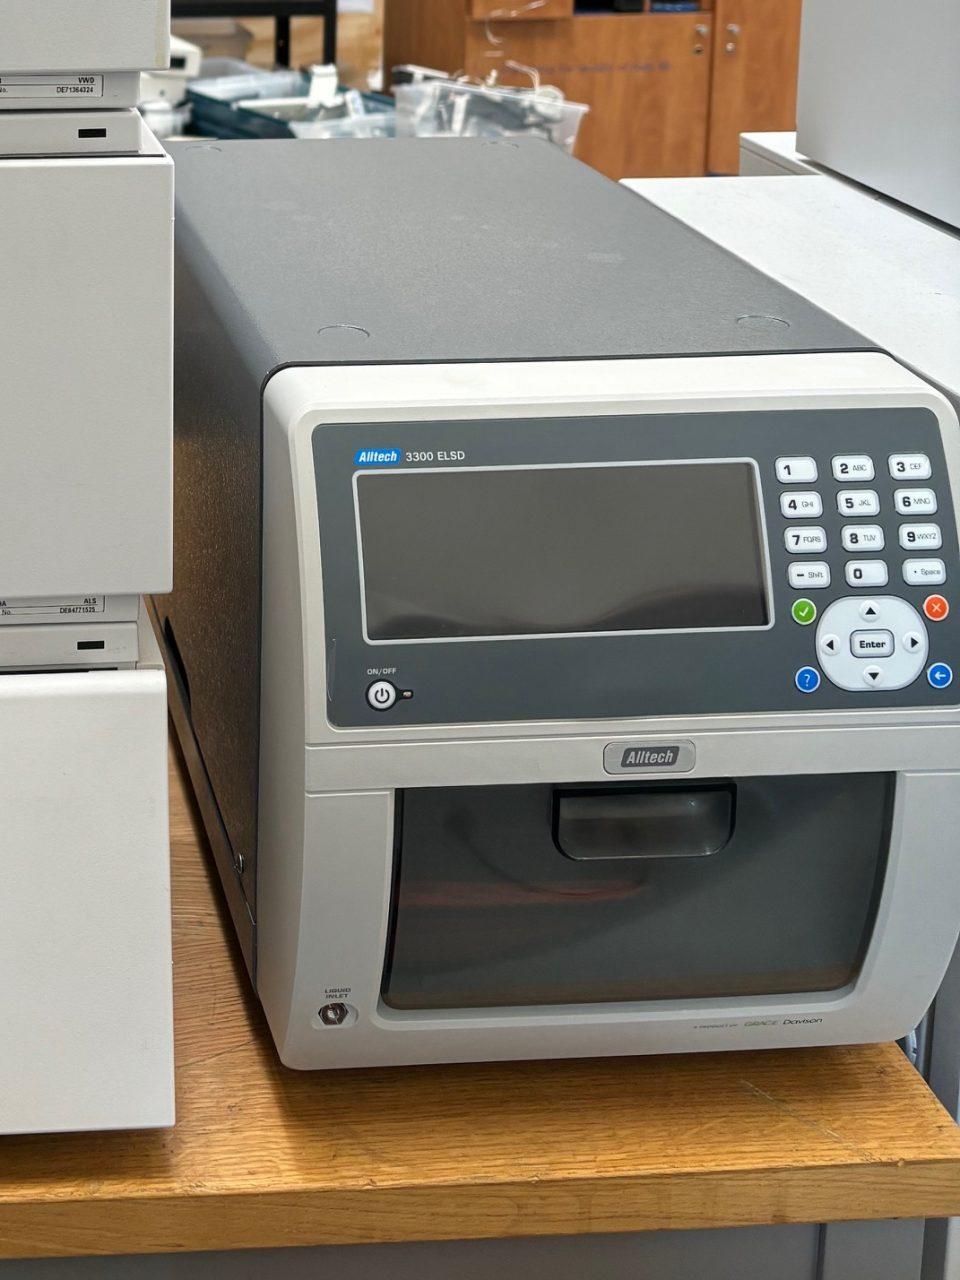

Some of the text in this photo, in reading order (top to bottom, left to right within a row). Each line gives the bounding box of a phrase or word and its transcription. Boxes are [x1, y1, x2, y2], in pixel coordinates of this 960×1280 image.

[359, 451, 465, 462] Alltech 3300 ELSD
[784, 464, 791, 475] 1
[840, 463, 849, 474] 2
[896, 462, 906, 472] 3
[788, 499, 797, 511] 4
[845, 497, 854, 509] 5
[902, 496, 911, 507] 6
[792, 535, 800, 546] 7
[849, 533, 859, 544] 8
[906, 531, 916, 542] 9
[808, 571, 824, 579] Shift
[853, 568, 863, 579] 0
[920, 568, 941, 576] Space
[859, 640, 886, 649] Enter
[367, 667, 397, 675] ON/OFF
[626, 750, 674, 764] Alltech
